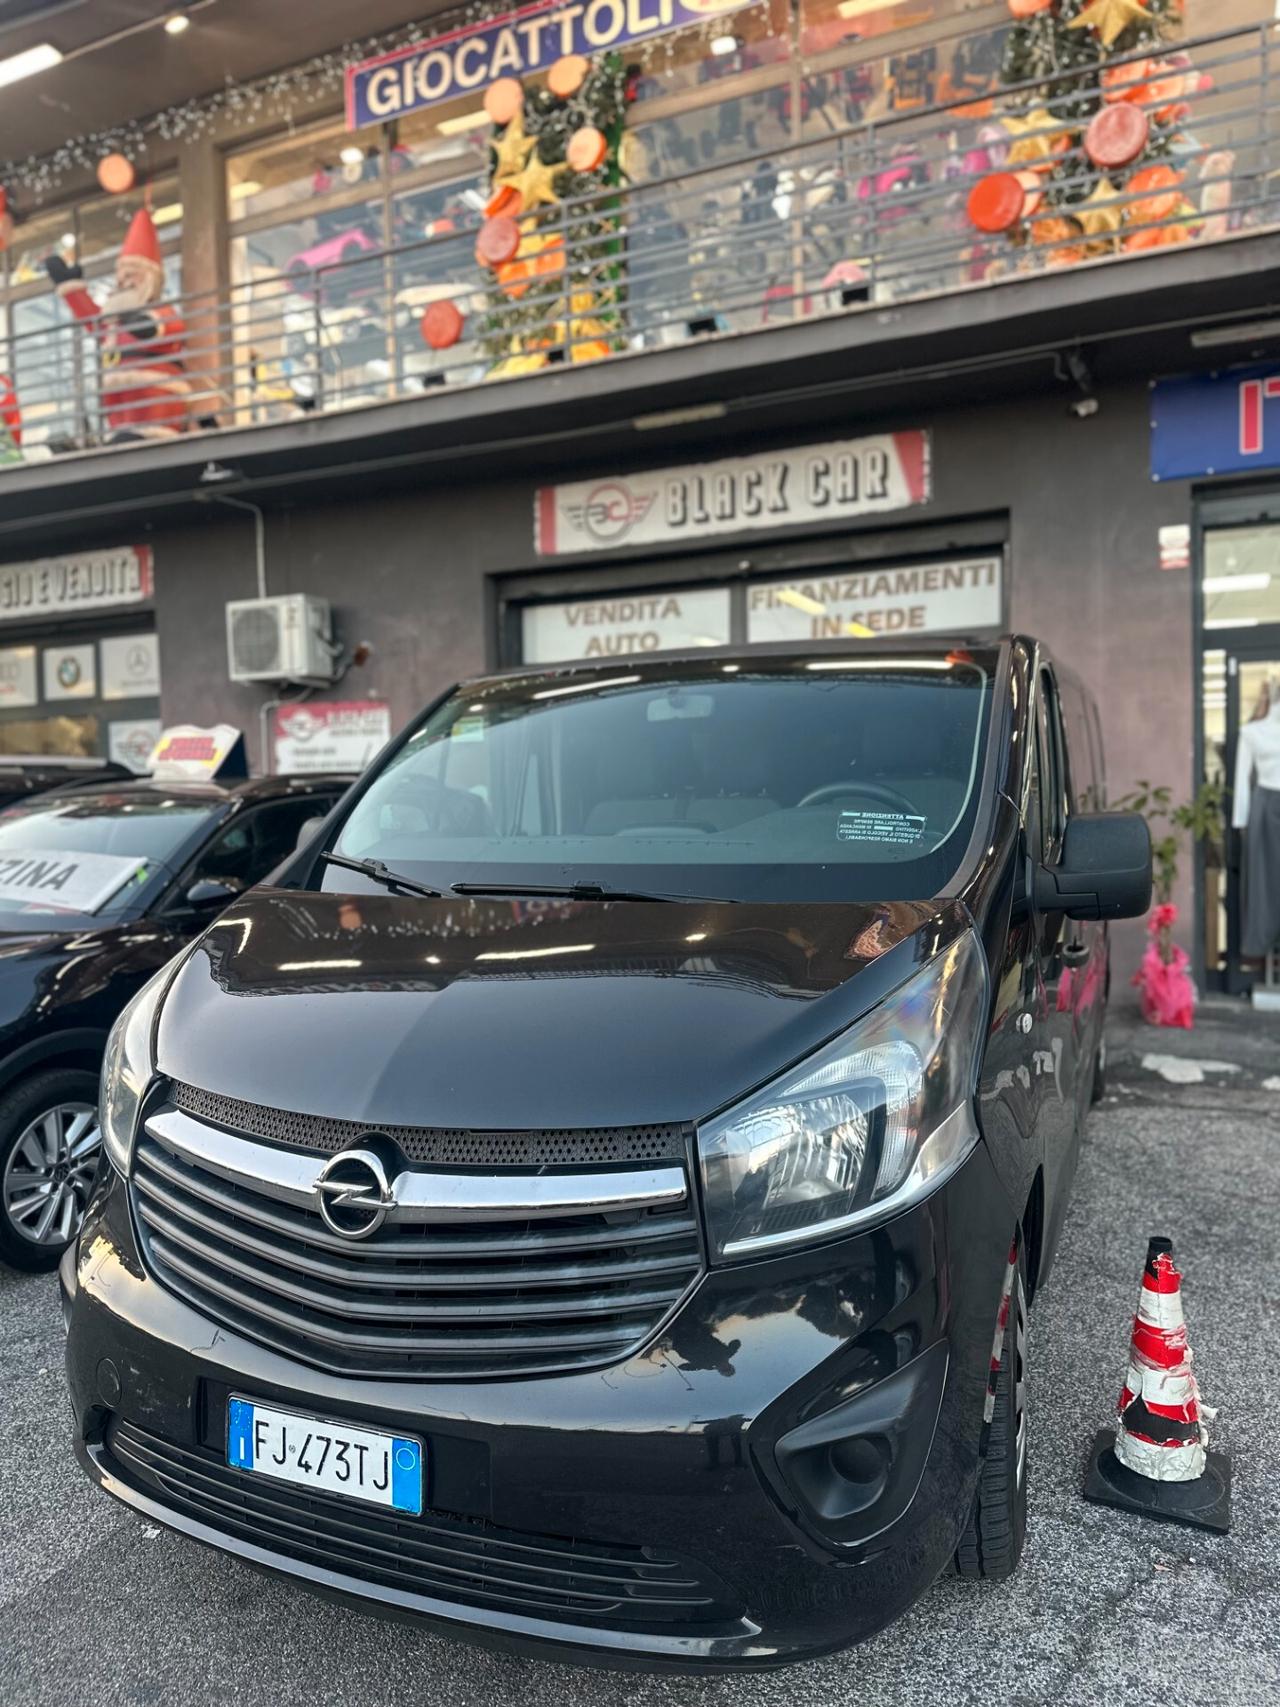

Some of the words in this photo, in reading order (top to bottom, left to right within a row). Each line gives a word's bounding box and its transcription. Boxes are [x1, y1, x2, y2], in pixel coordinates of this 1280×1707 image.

[664, 461, 790, 528] BLACK
[805, 448, 889, 506] CAR
[750, 564, 996, 612] FINANZIAMENTI
[564, 598, 682, 628] VENDITA
[811, 615, 843, 640] IN
[583, 632, 660, 658] AUTO
